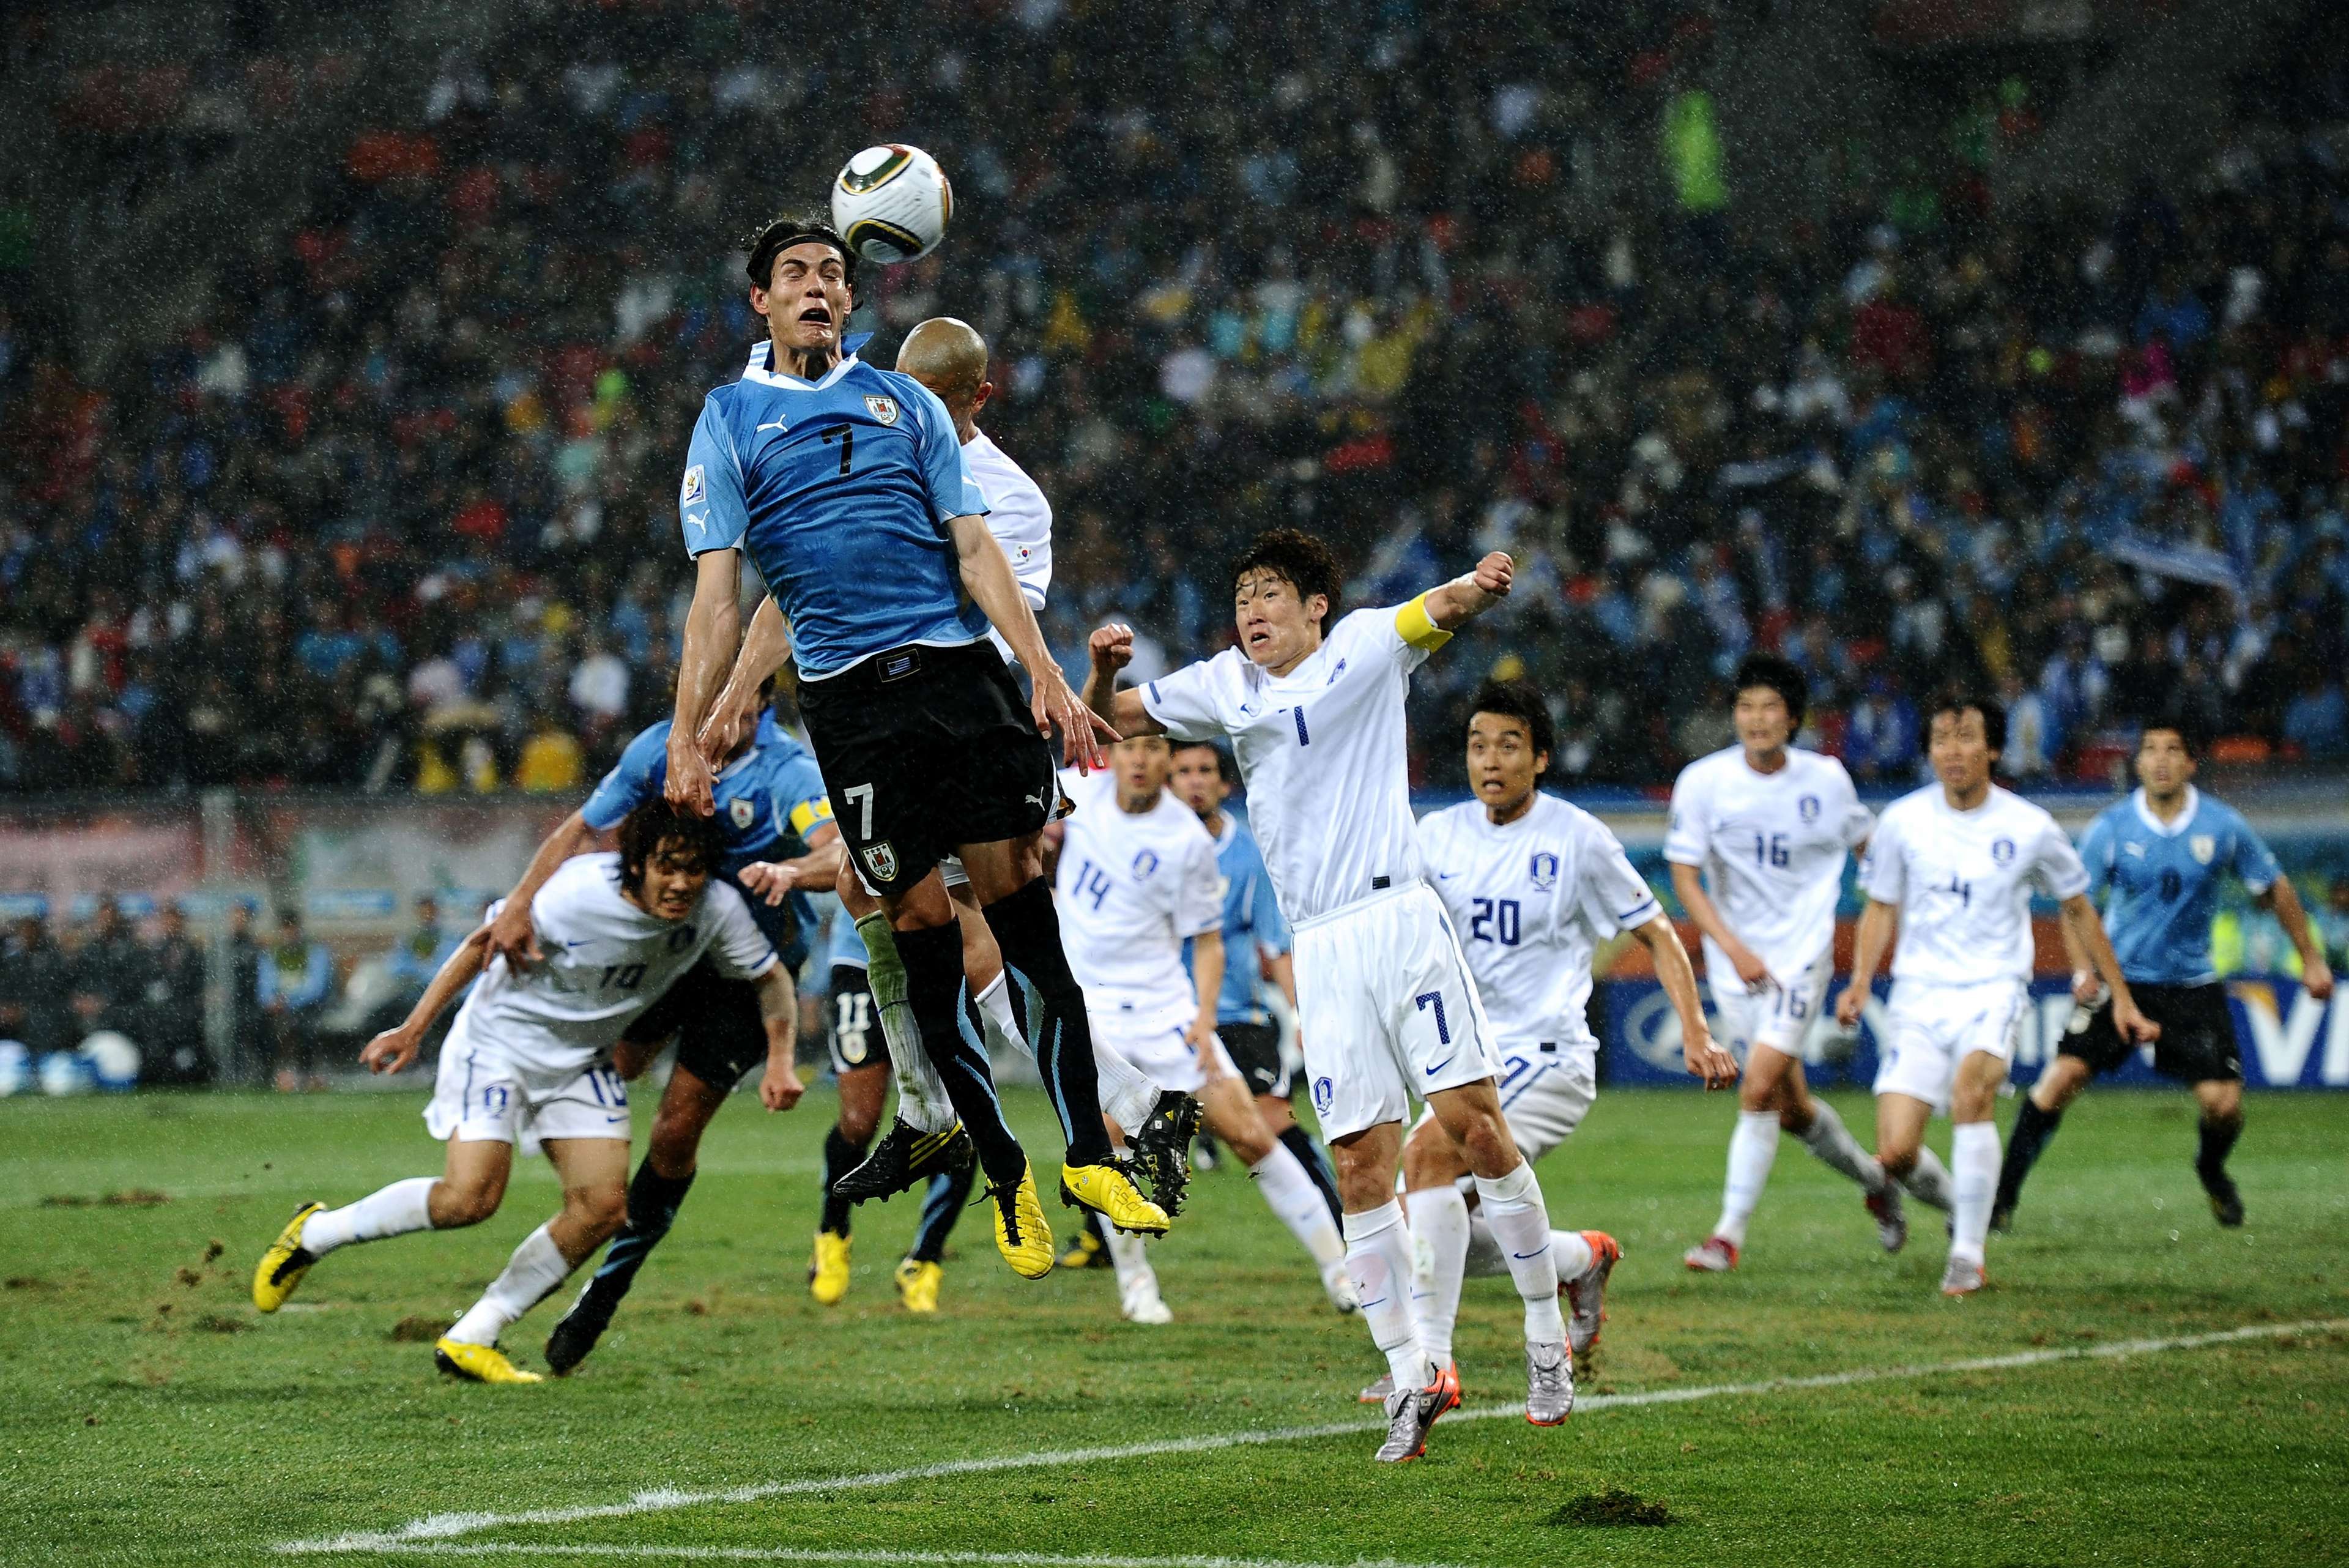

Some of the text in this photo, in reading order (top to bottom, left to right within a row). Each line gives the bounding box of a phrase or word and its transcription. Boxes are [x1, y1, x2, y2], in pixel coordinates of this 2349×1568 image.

[822, 422, 853, 477] 7
[844, 782, 874, 841] 7
[1755, 833, 1789, 868] 16
[1073, 861, 1110, 910] 14
[1472, 898, 1520, 946] 20
[836, 992, 872, 1035] 11
[1416, 990, 1450, 1045] 7
